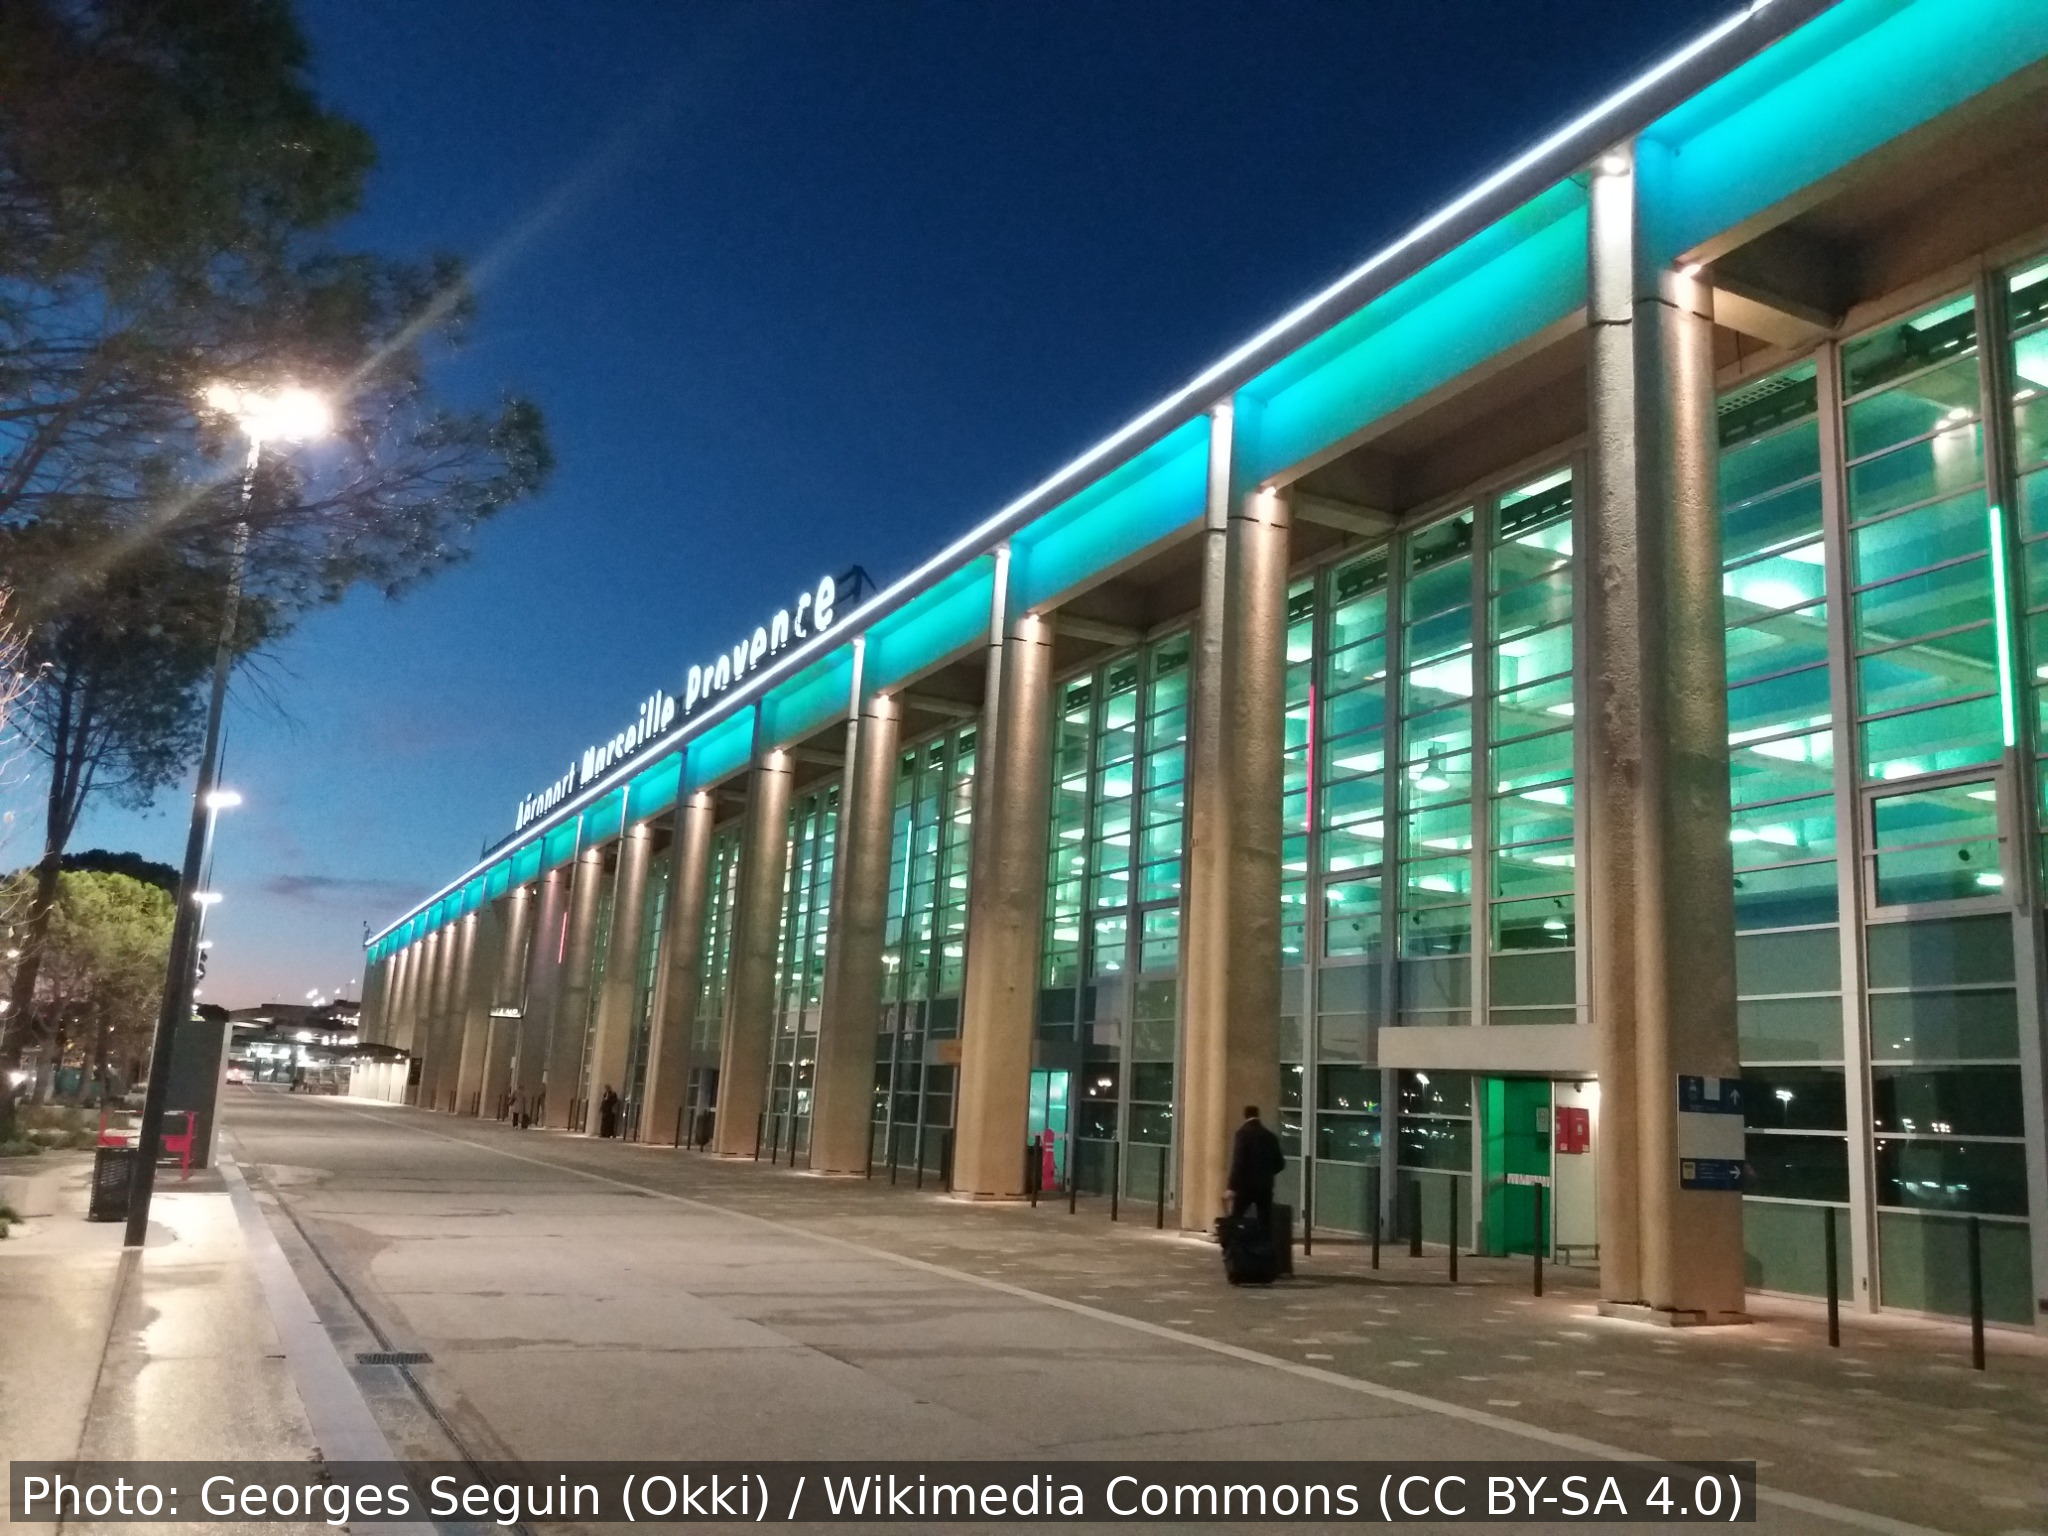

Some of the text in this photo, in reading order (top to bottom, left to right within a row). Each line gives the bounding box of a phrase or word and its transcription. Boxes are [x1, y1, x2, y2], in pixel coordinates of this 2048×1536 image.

[515, 575, 836, 832] Aéroport Marseille Provence
